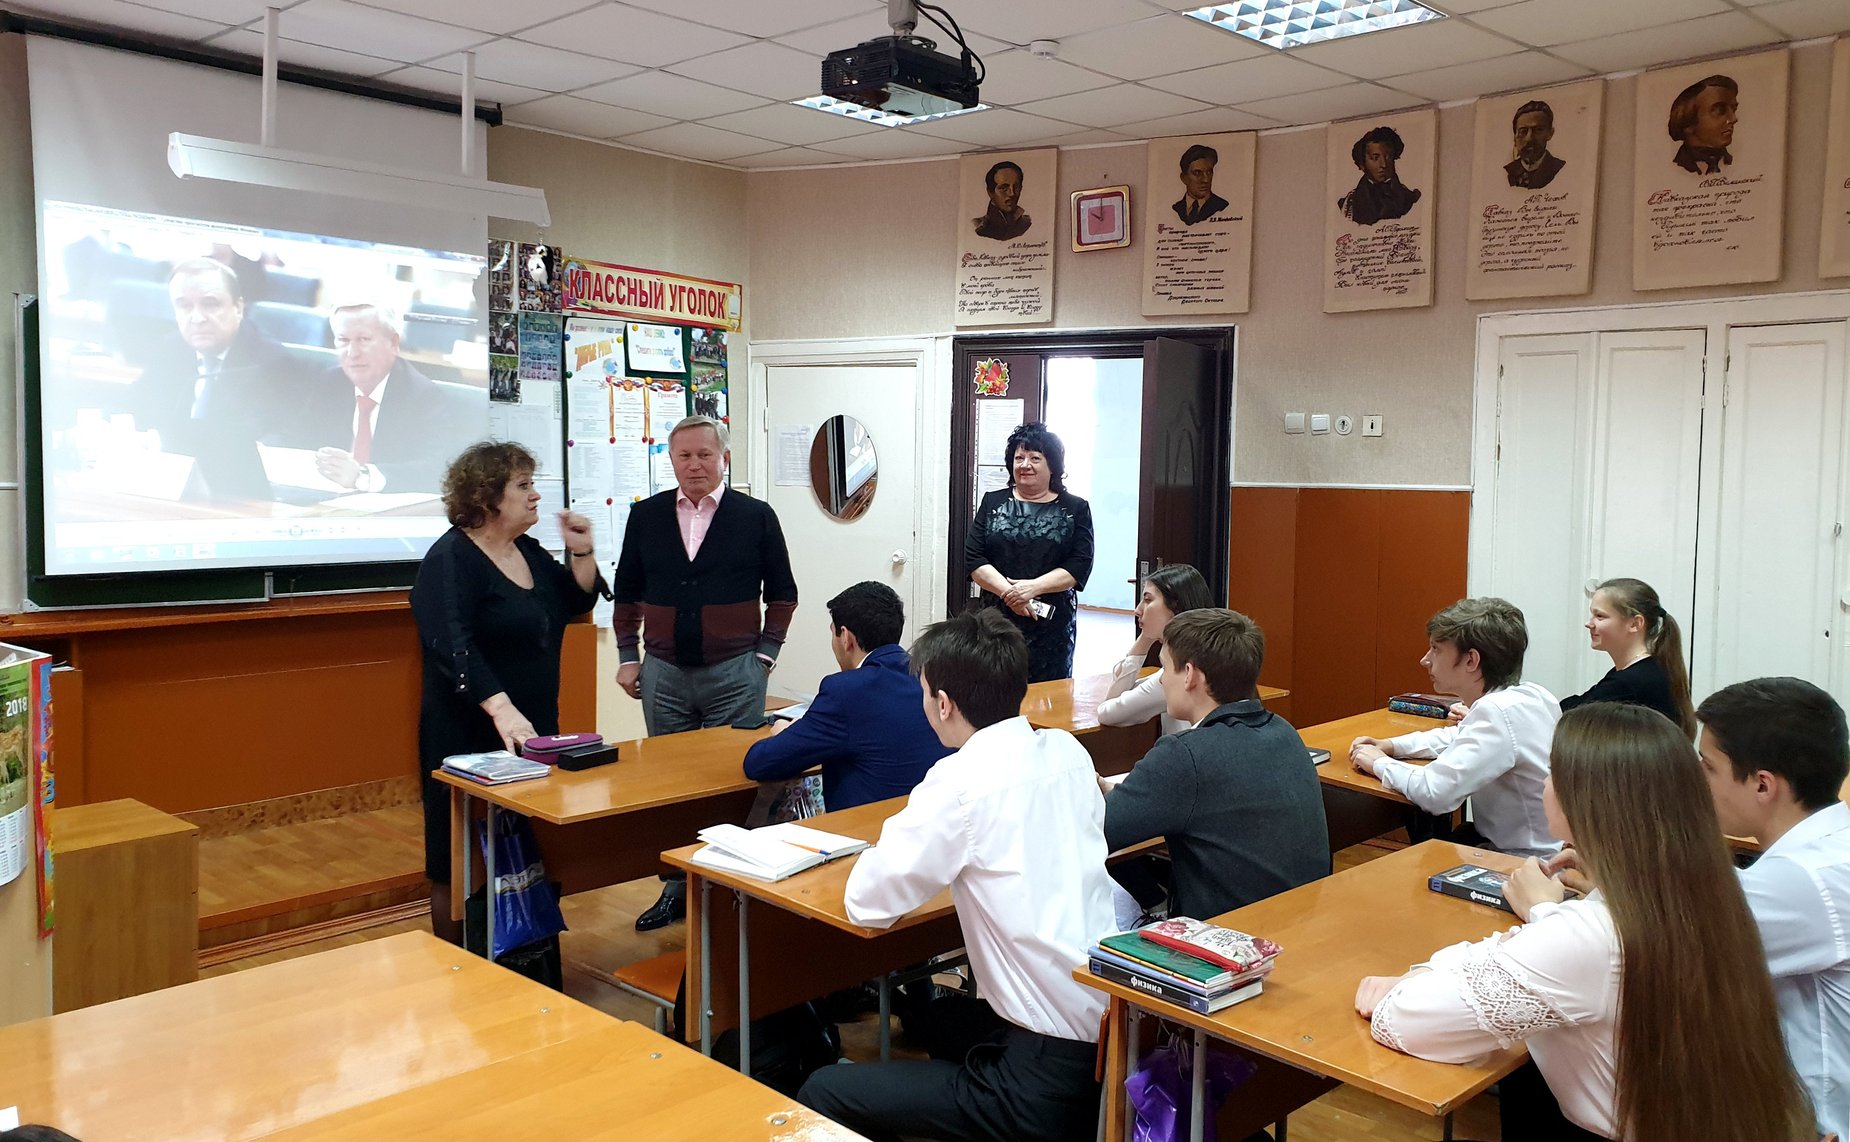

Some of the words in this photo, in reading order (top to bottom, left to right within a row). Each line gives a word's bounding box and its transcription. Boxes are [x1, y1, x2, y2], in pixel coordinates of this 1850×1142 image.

[570, 269, 663, 311] КЛАССНЫЙ
[669, 284, 727, 319] УГОЛОК
[6, 696, 28, 717] 2018
[1130, 975, 1163, 995] физика
